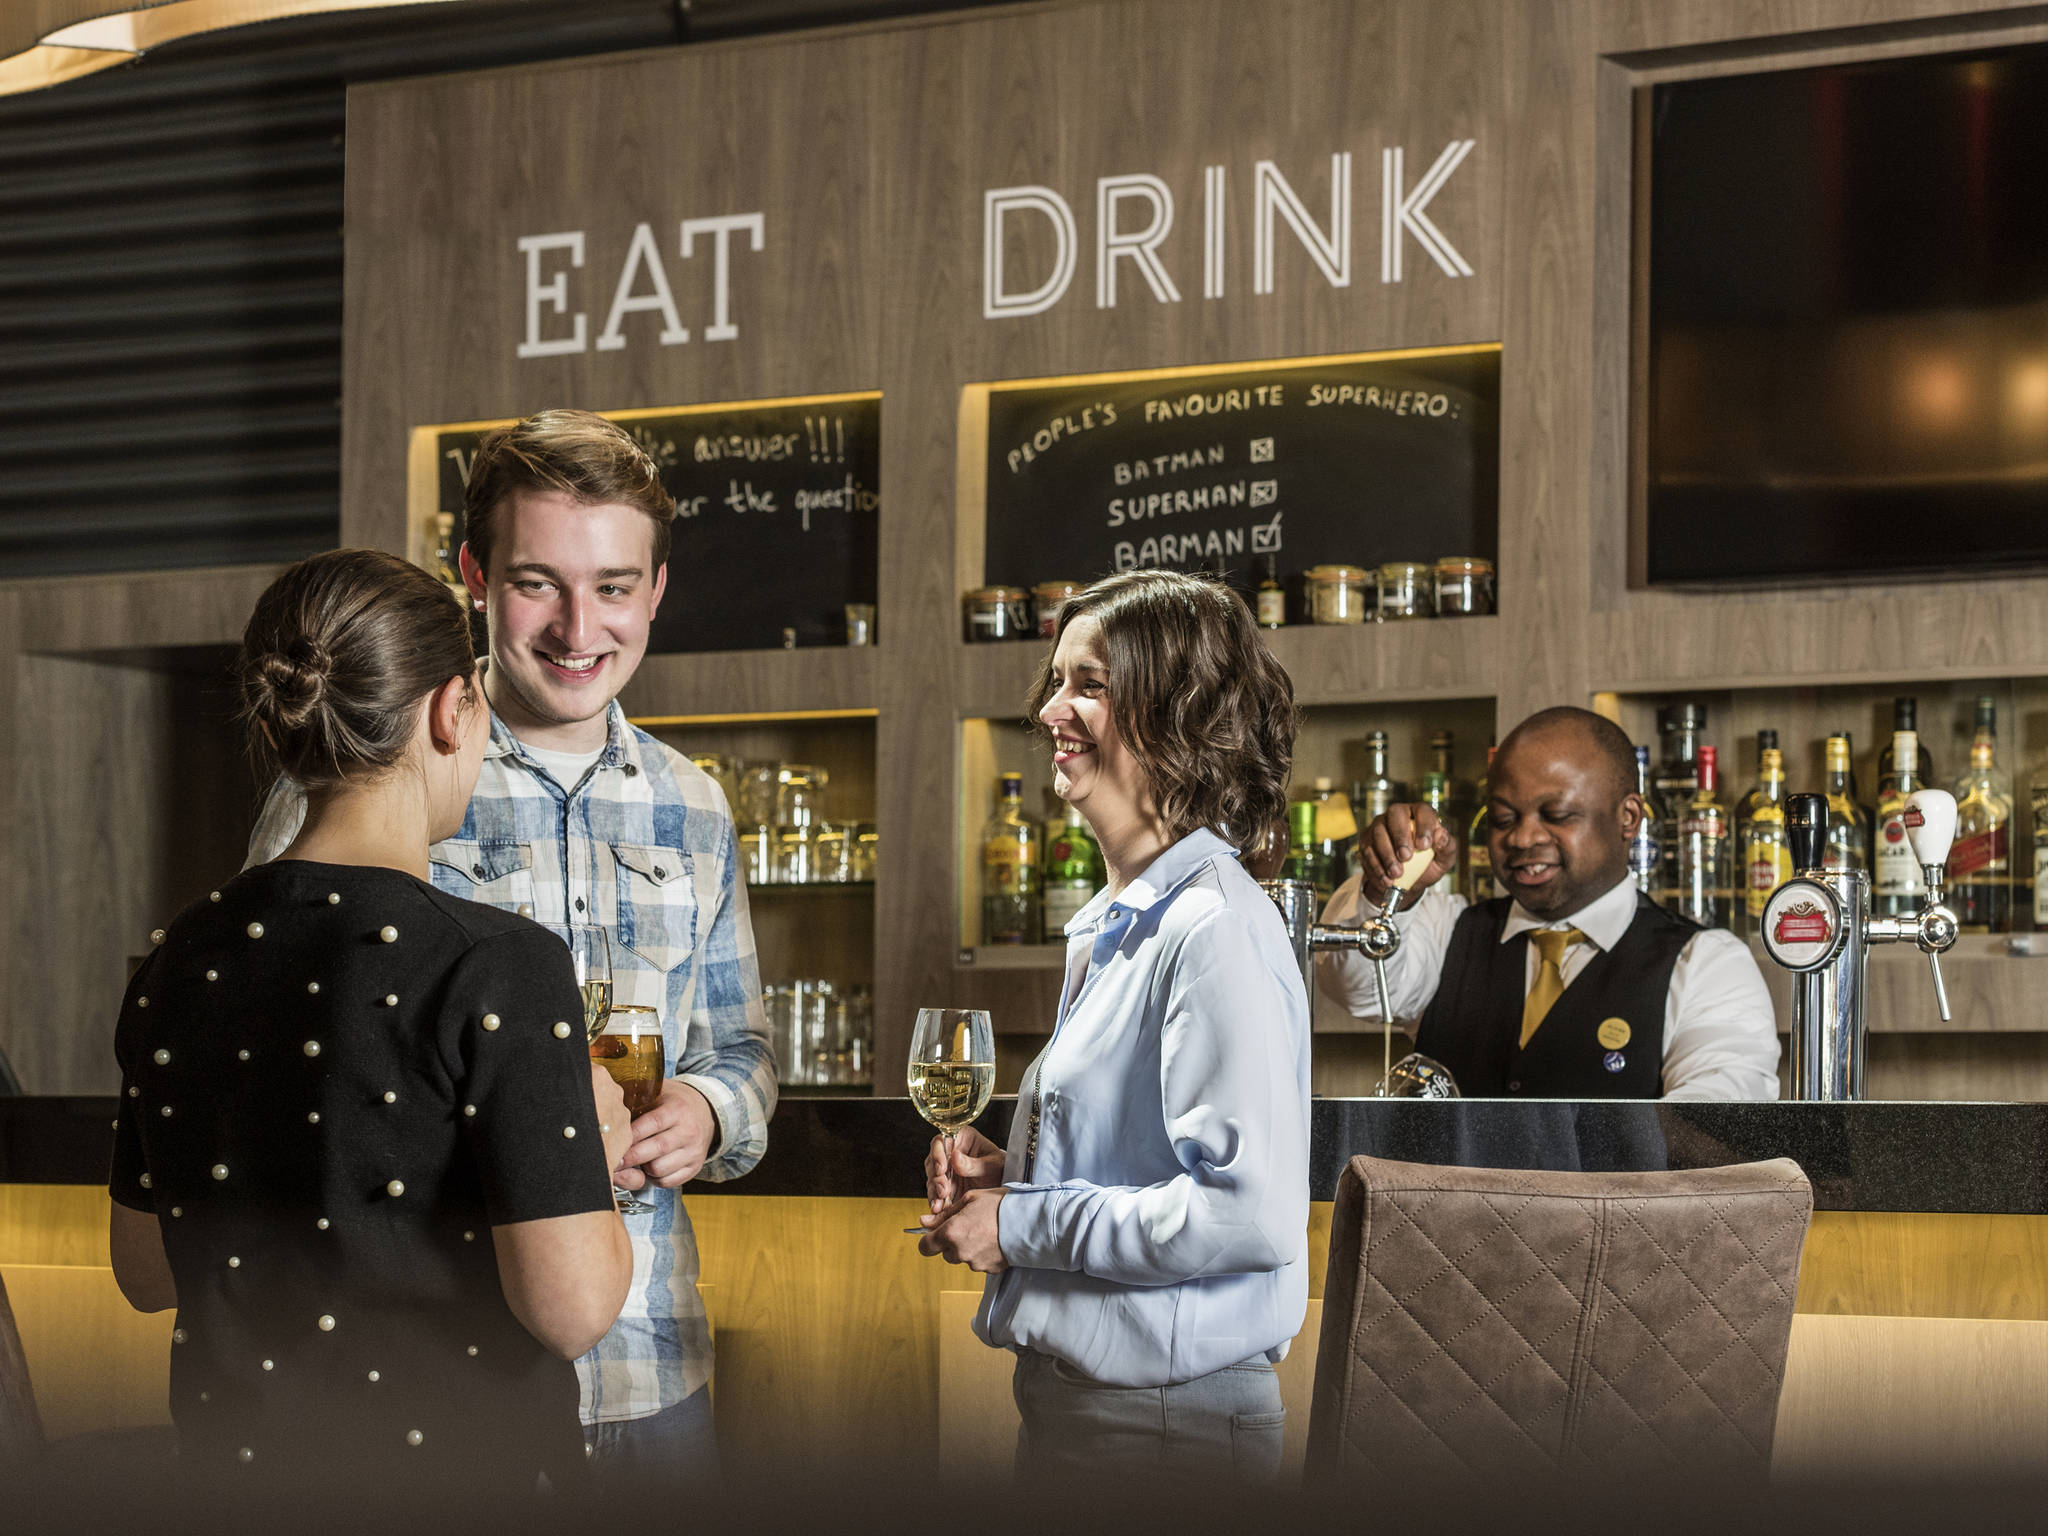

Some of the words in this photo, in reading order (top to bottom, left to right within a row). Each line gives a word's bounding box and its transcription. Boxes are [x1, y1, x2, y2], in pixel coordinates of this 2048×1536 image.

[983, 140, 1476, 319] DRINK
[517, 213, 765, 357] EAT
[694, 434, 800, 462] answer
[1007, 402, 1118, 474] PEOPLE'S
[1144, 385, 1284, 423] FAVOURITE
[1113, 443, 1225, 486] BATMAN
[724, 479, 778, 513] the
[1114, 527, 1244, 573] BARMAN
